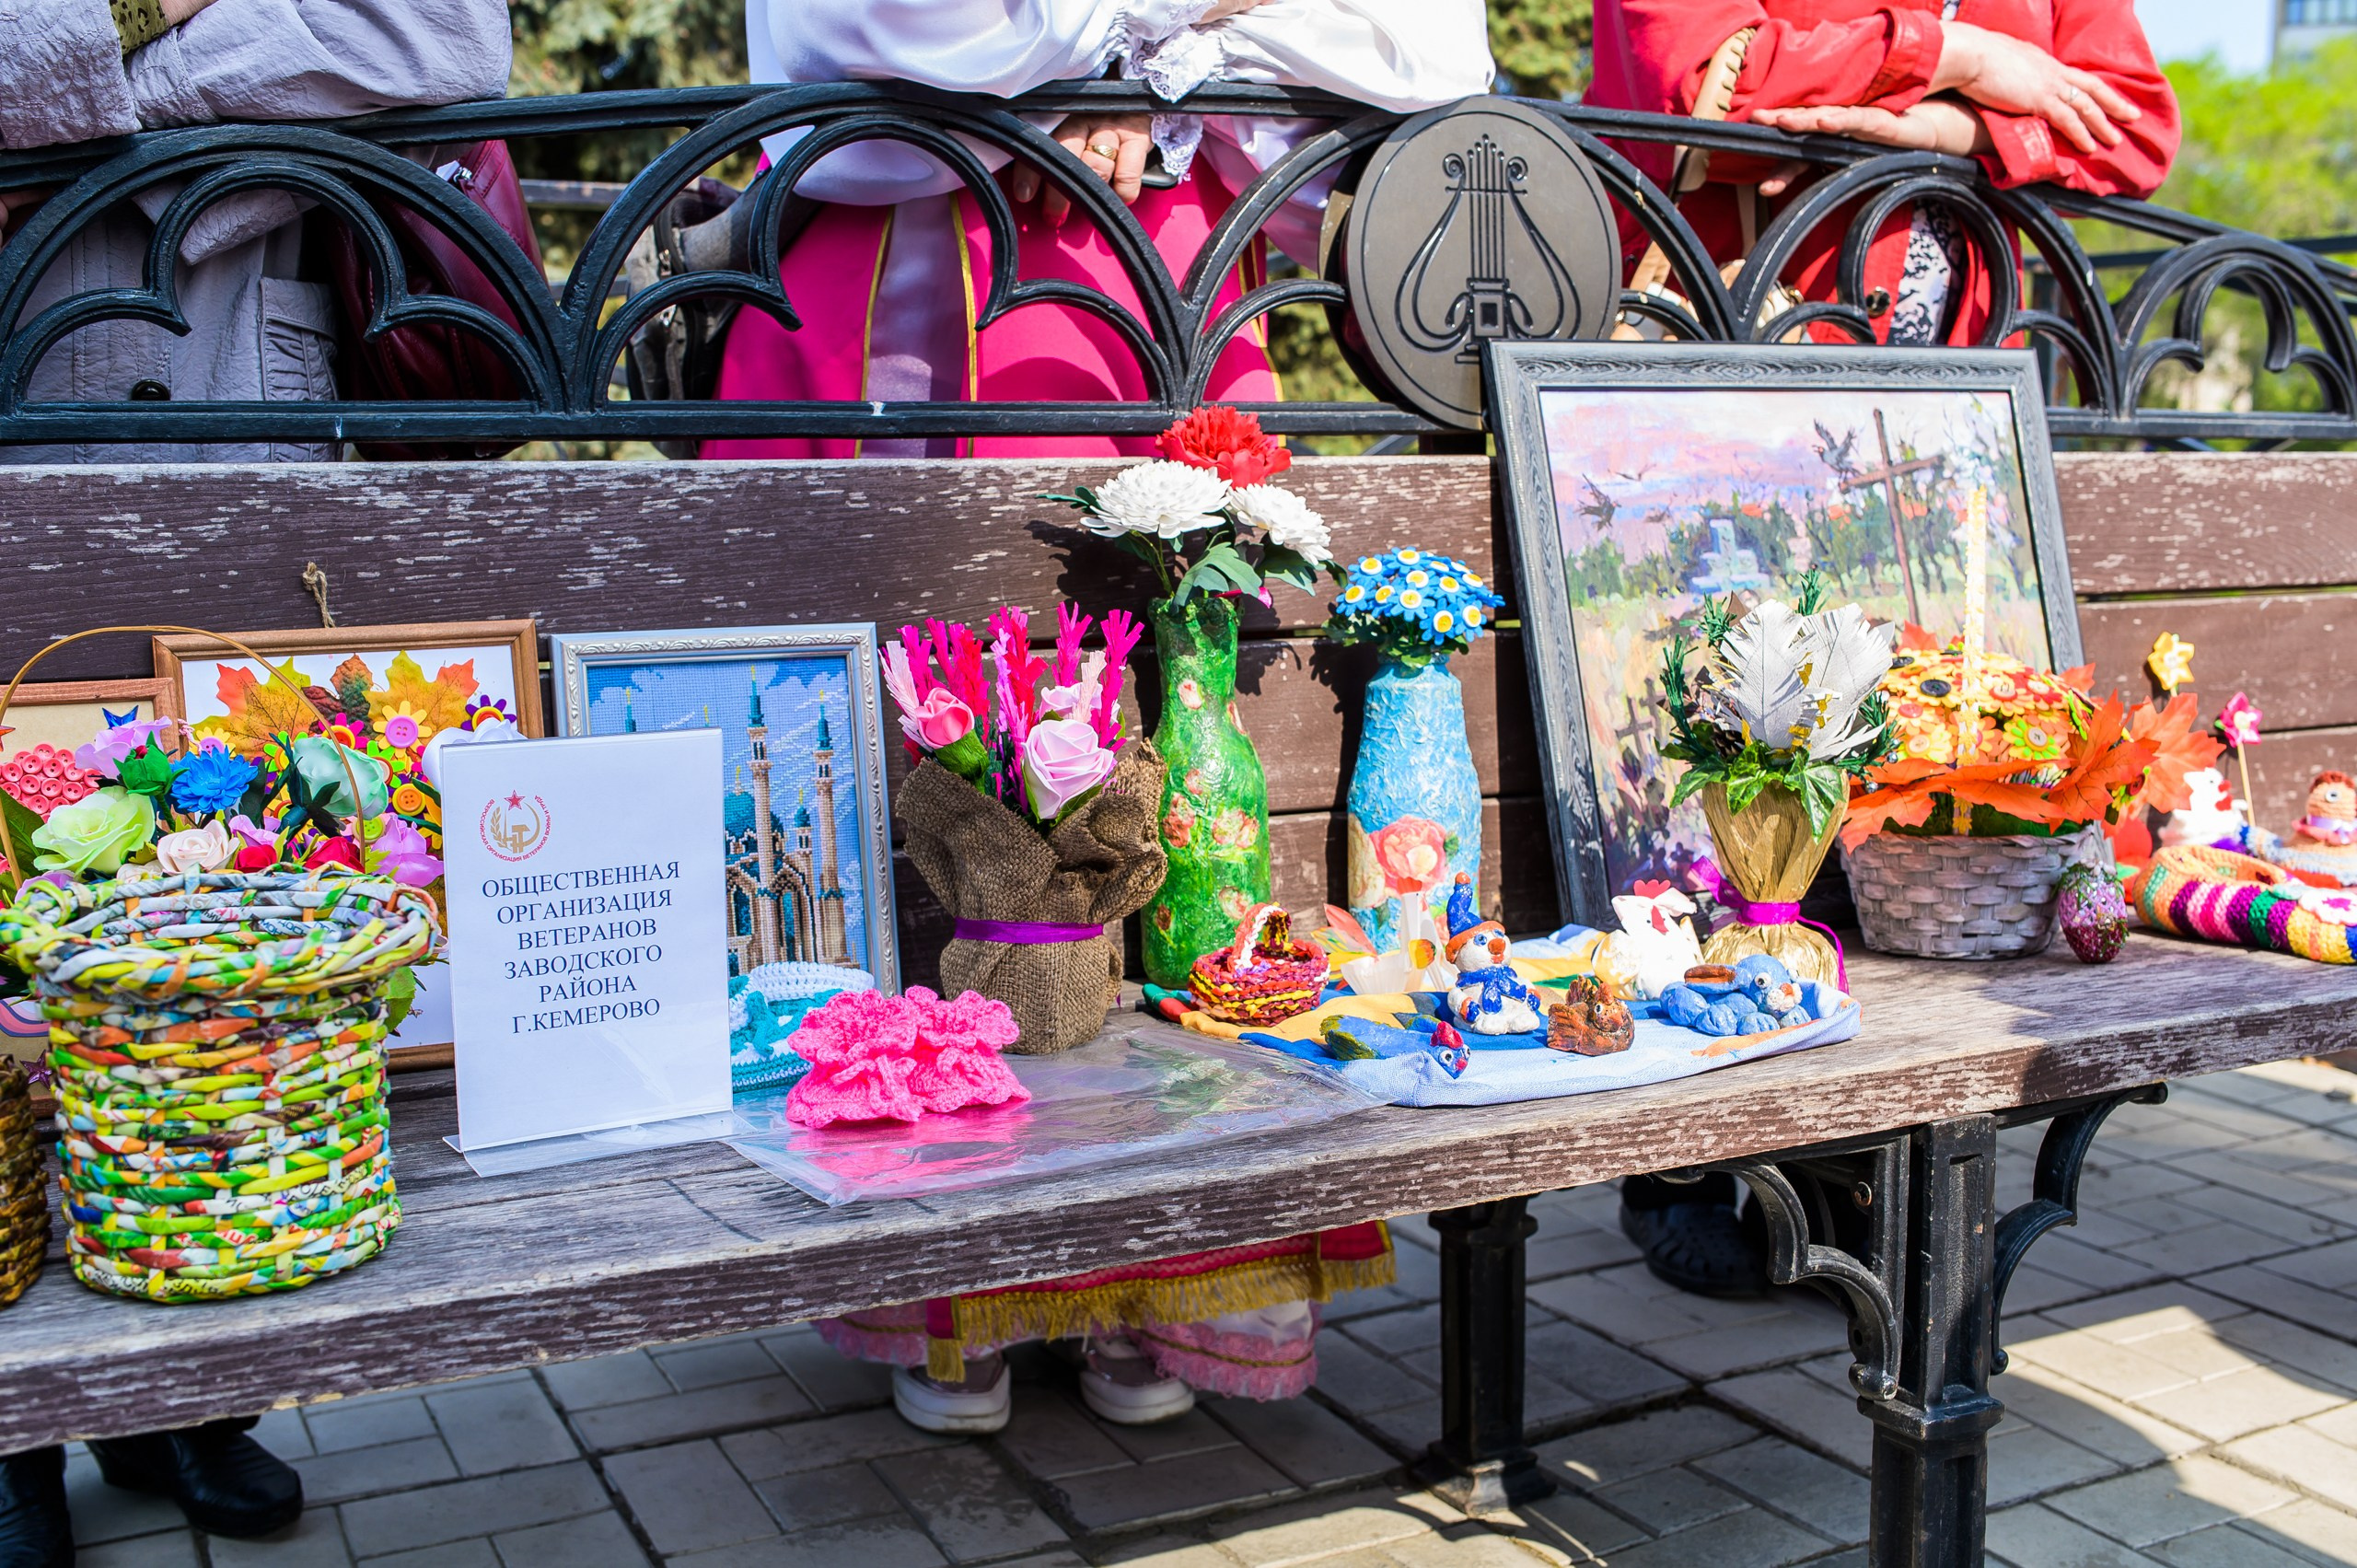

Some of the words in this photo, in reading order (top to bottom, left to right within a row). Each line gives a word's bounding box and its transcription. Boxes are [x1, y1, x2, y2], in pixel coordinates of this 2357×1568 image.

[486, 844, 523, 863] ОРГАНИЗАЦИЯ
[522, 836, 548, 861] ВЕТЕРАНОВ
[482, 861, 680, 898] ОБЩЕСТВЕННАЯ
[496, 889, 672, 924] ОРГАНИЗАЦИЯ
[517, 918, 657, 950] ВЕТЕРАНОВ
[505, 944, 662, 980] ЗАВОДСКОГО
[539, 974, 637, 1004] РАЙОНА
[512, 998, 660, 1034] Г.КЕМЕРОВО
